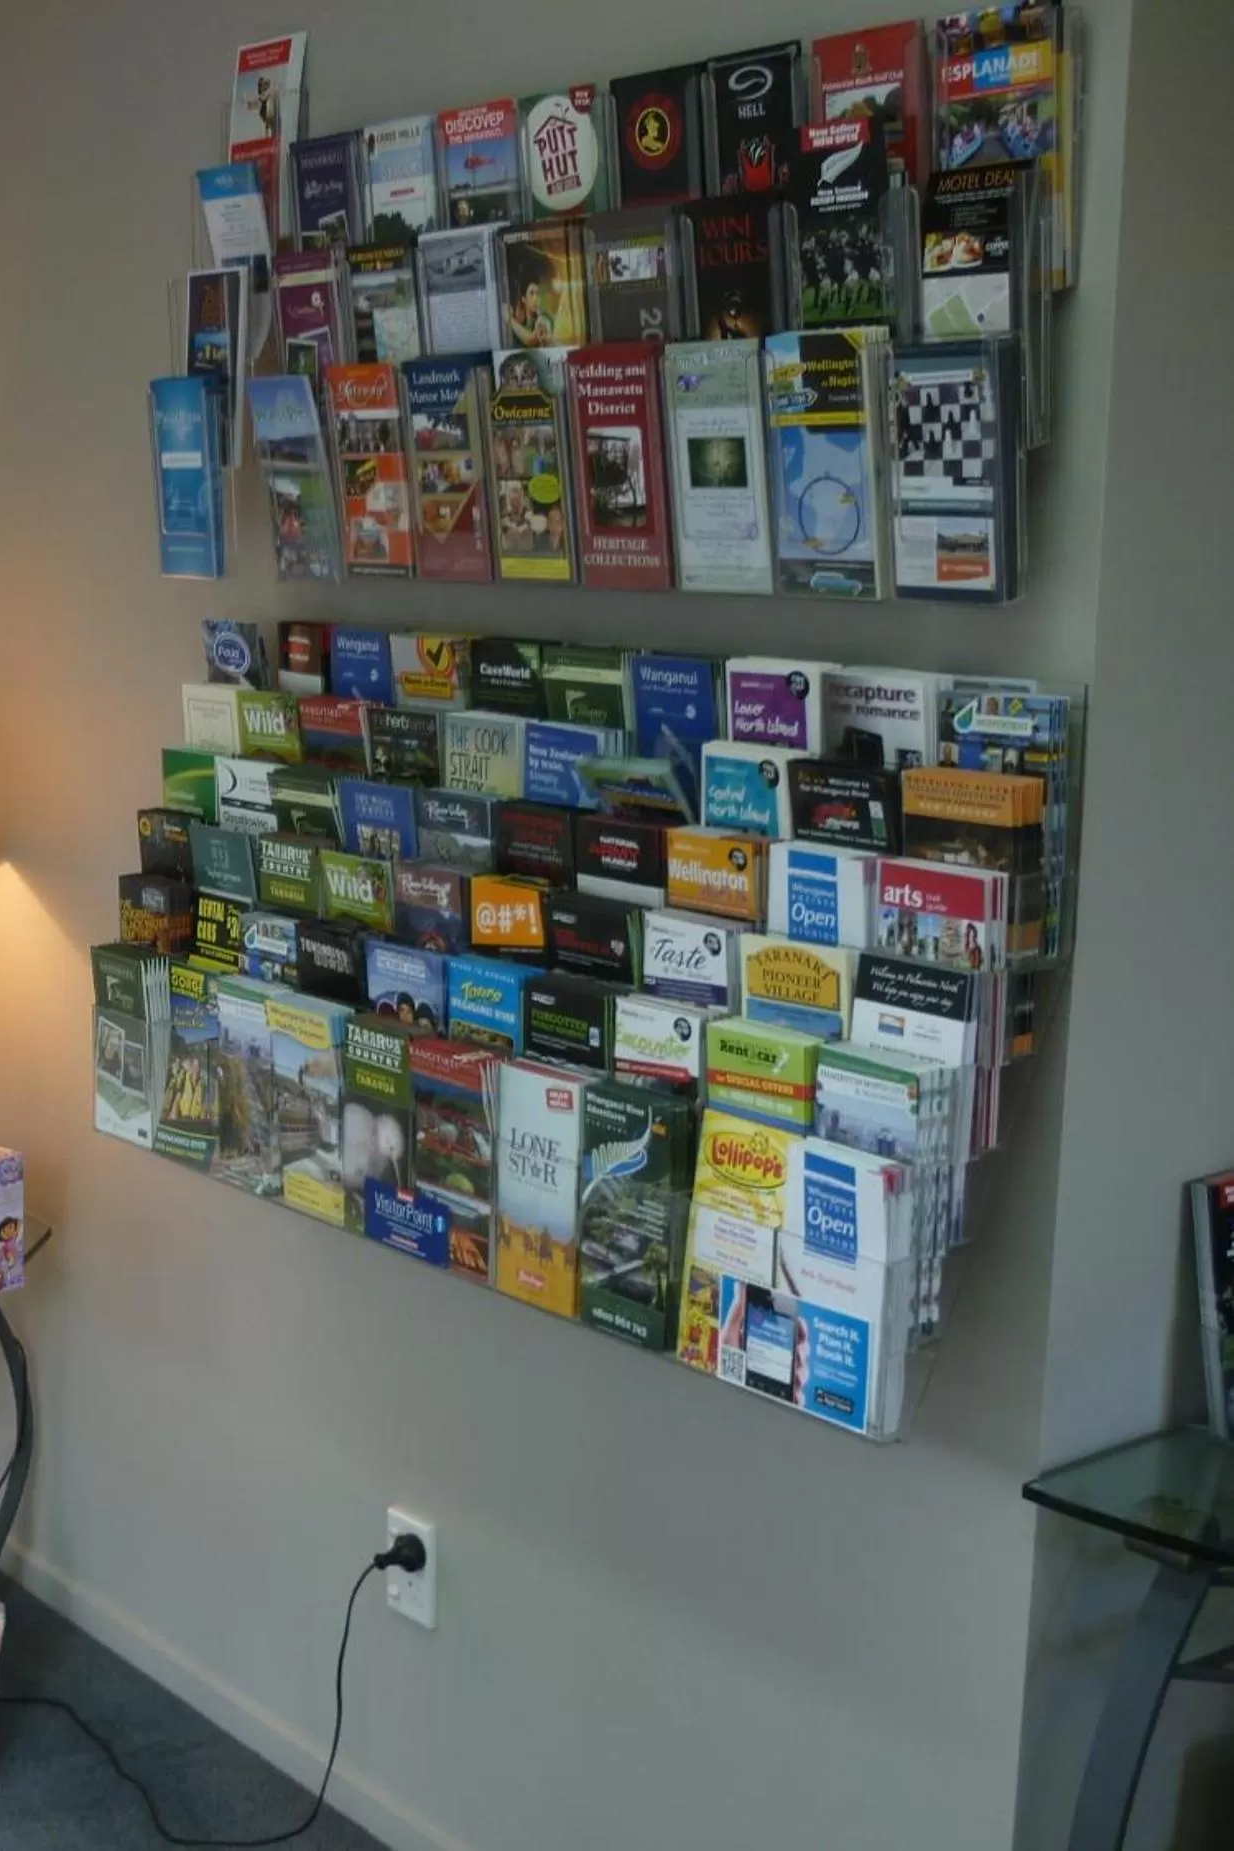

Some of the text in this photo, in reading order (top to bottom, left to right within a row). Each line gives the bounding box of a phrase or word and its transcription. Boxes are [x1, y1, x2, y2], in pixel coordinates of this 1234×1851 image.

[445, 110, 505, 135] DISCOVER
[737, 104, 766, 119] HELL
[536, 124, 578, 158] PUTT
[541, 150, 579, 182] HUT
[937, 172, 981, 193] MOTEL
[701, 213, 755, 239] WINE
[700, 241, 766, 267] TOURS
[412, 368, 461, 386] Landmark
[570, 364, 646, 381] Feilding and
[577, 382, 644, 397] Manawatu
[588, 401, 636, 416] District
[593, 537, 648, 551] HERITAGE
[584, 554, 661, 568] COLLECTIONS
[639, 664, 699, 687] Wanganui
[243, 708, 287, 735] Wild
[855, 705, 921, 721] romance
[449, 724, 509, 754] THE COOK
[735, 716, 800, 738] North Island
[449, 752, 492, 781] STRAIT
[708, 802, 771, 824] North Island
[325, 867, 374, 904] Wild
[668, 857, 749, 893] Wellington
[883, 883, 924, 908] arts
[198, 897, 226, 922] RENTAL
[791, 902, 836, 928] Open
[197, 920, 217, 943] CARS
[653, 937, 707, 971] Taste
[761, 968, 823, 989] PIONEER
[762, 983, 821, 1003] VILLAGE
[719, 1039, 778, 1067] Rent car
[510, 1127, 561, 1162] LONE
[711, 1136, 784, 1181] Lollipop's
[807, 1206, 855, 1238] Open
